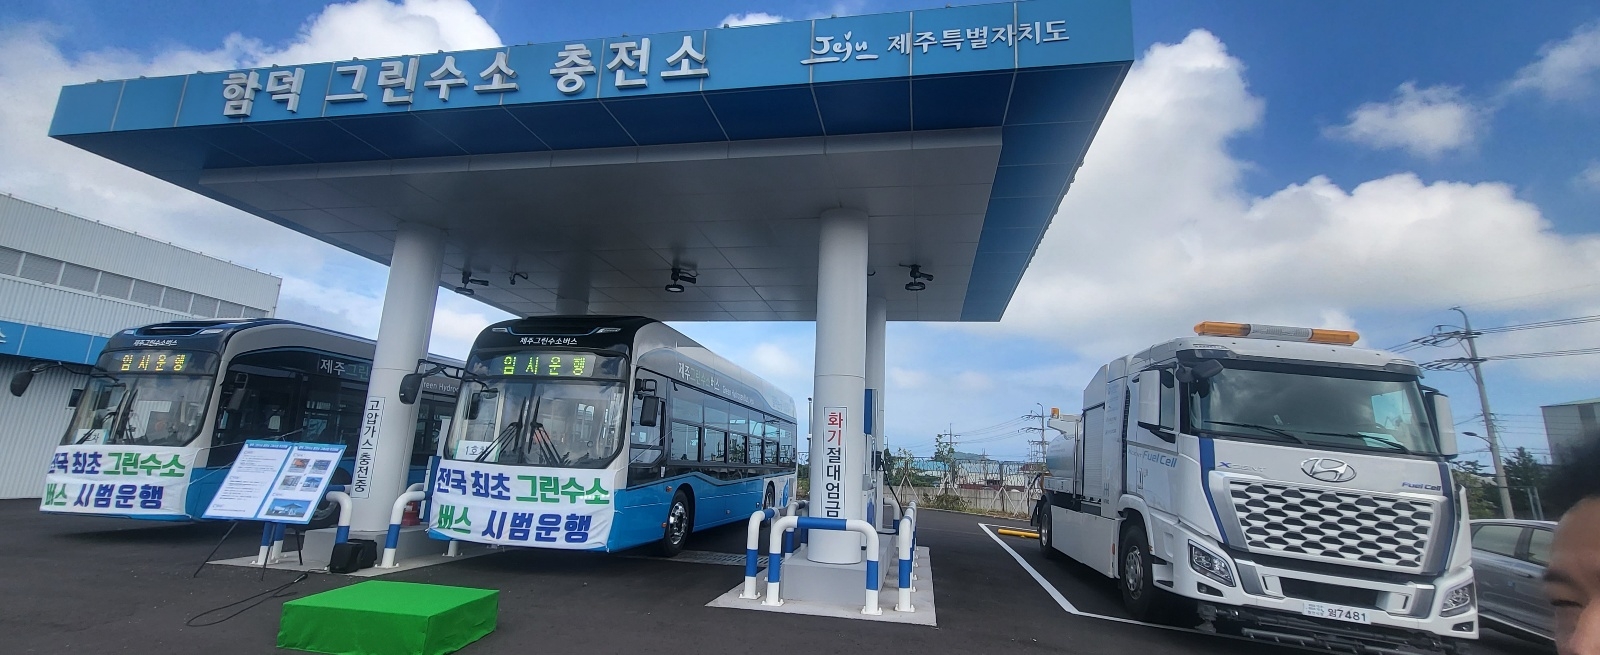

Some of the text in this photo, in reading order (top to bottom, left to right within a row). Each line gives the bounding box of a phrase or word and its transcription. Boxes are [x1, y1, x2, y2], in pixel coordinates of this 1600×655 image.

[801, 31, 878, 64] Jeju
[887, 20, 1069, 54] 제주특별자치도
[222, 35, 709, 118] 함덕 그린수소 충전소
[519, 337, 577, 345] 제주그린수소버스
[355, 400, 380, 493] 고압가스충전중
[1143, 450, 1160, 463] Fuel
[1160, 456, 1178, 468] Cell
[72, 451, 102, 474] 최초
[103, 452, 186, 477] 그린수소
[44, 483, 164, 509] 버스 시범운행
[437, 467, 610, 504] 전국 최초 그린수소
[1402, 481, 1423, 489] Fuel
[437, 504, 592, 543] 버스 시범운행
